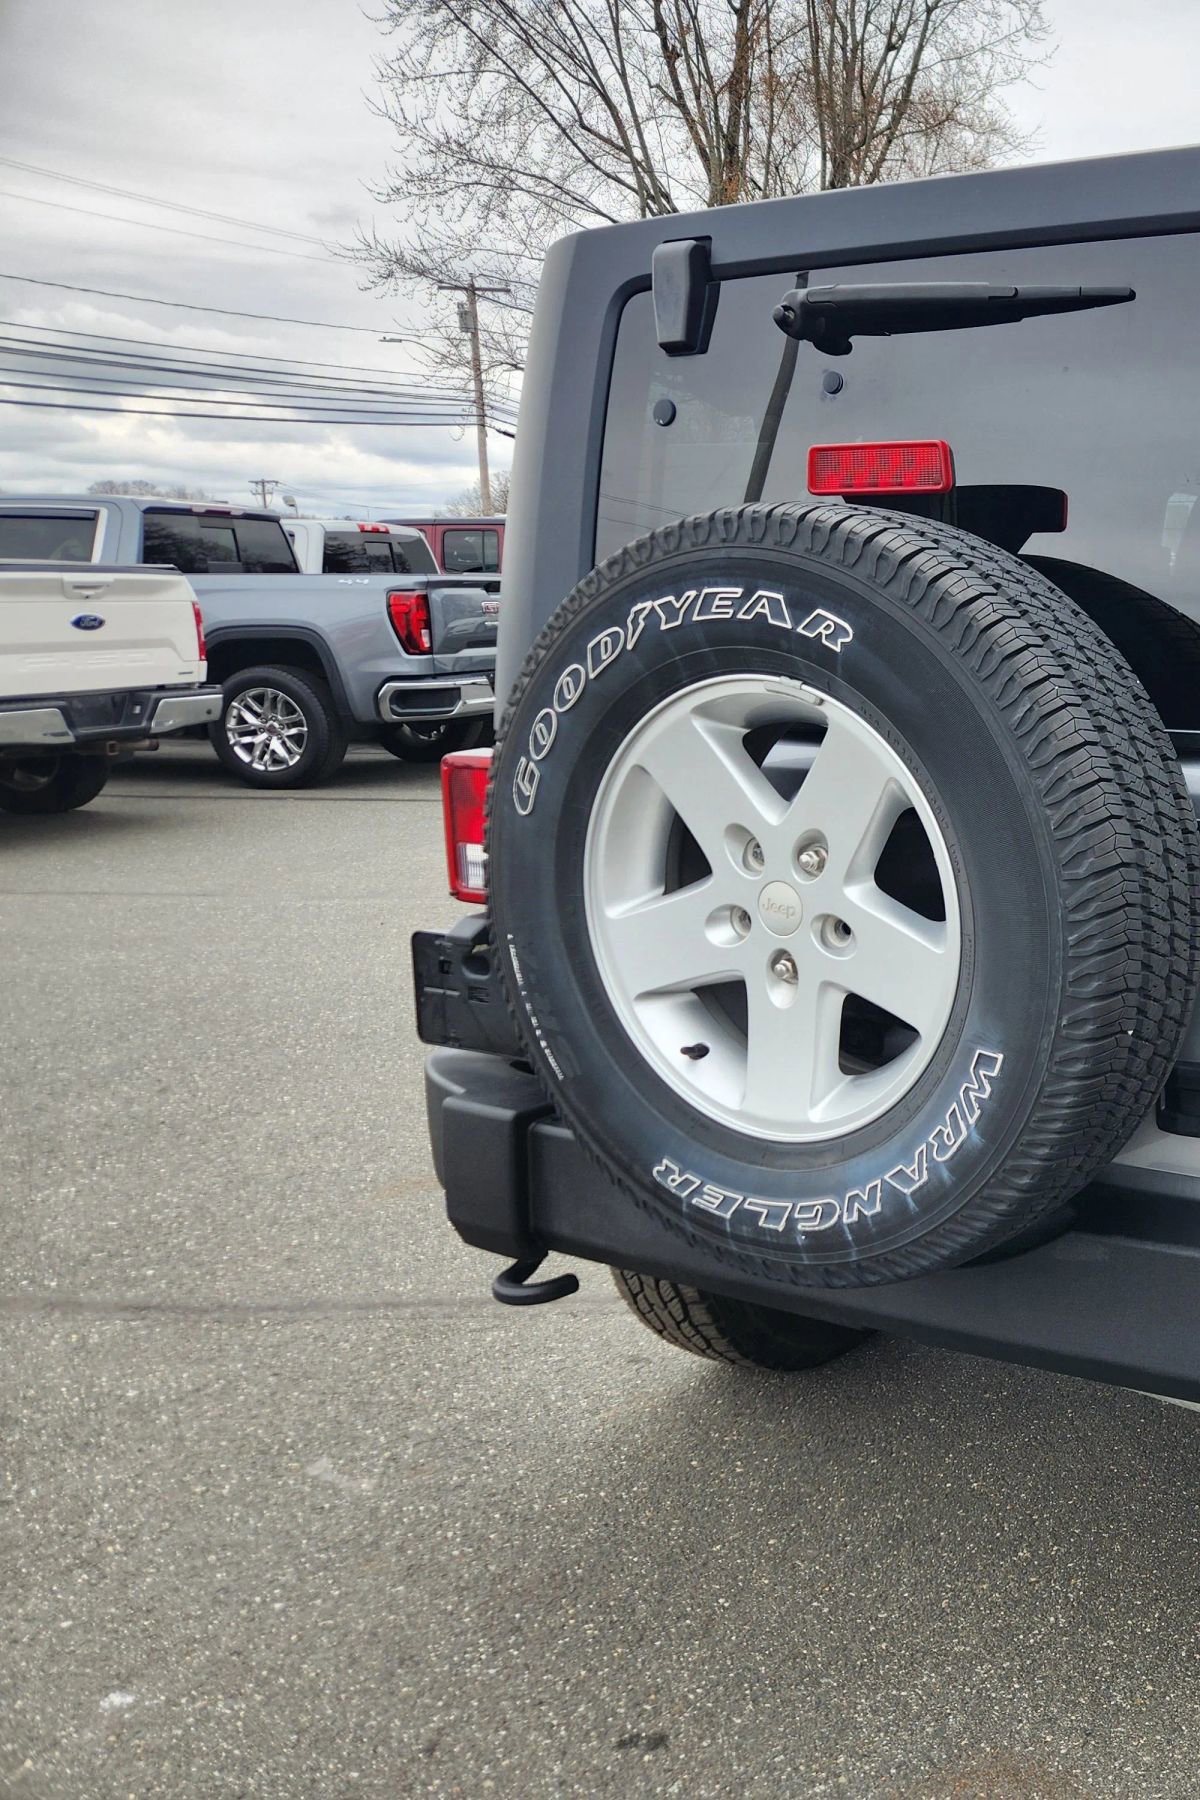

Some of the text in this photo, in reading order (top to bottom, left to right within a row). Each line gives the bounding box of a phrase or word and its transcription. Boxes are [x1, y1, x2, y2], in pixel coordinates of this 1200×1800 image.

[512, 587, 854, 816] GOODYEAR
[762, 897, 796, 920] Jeep
[652, 1050, 1004, 1232] WRANGLER
